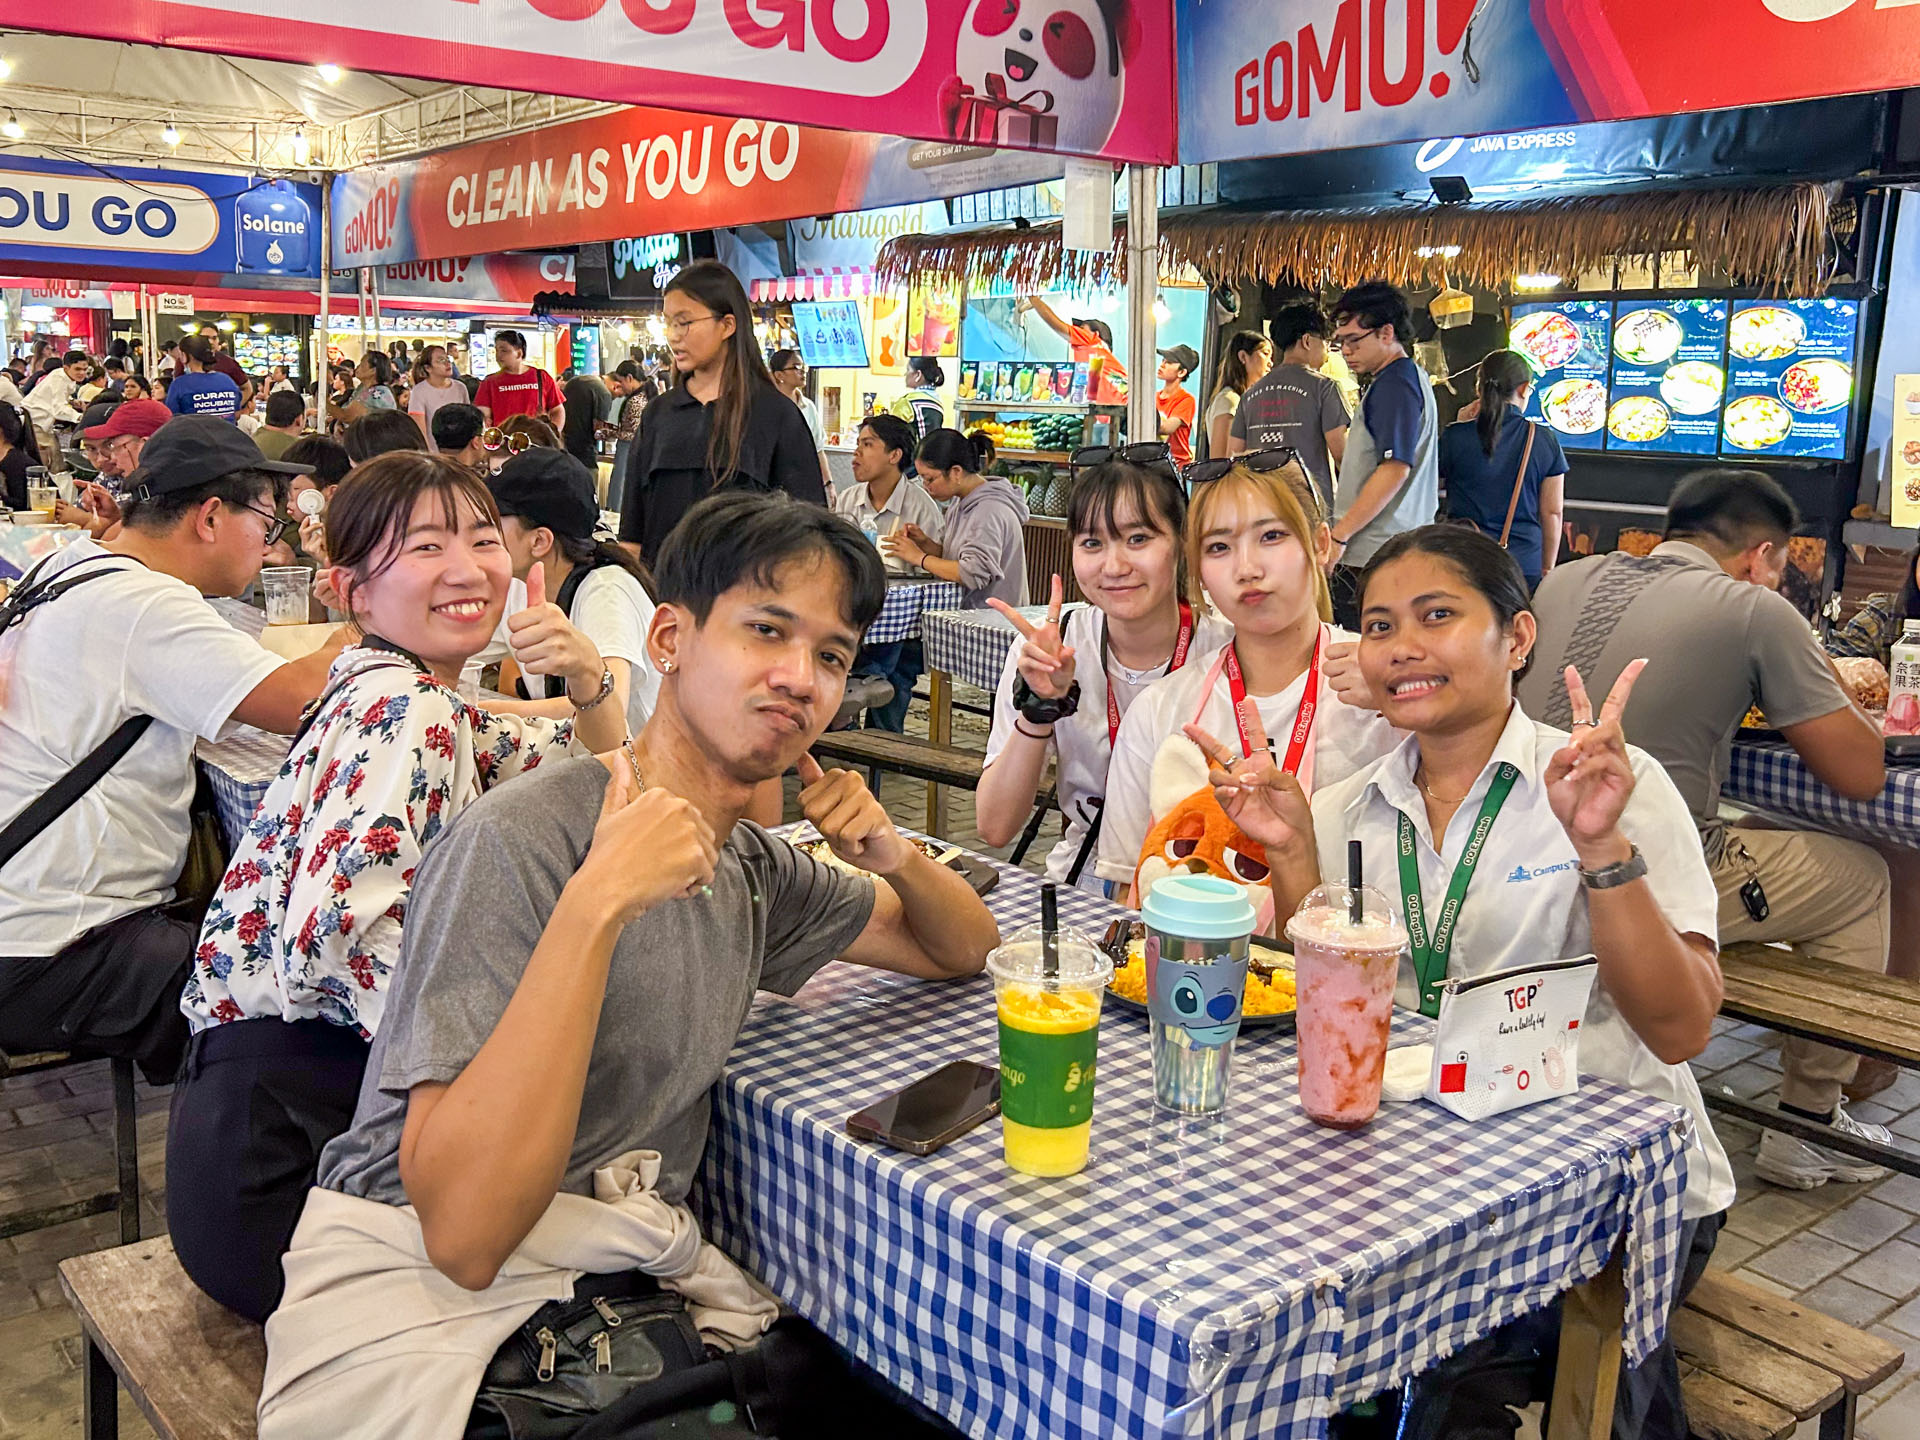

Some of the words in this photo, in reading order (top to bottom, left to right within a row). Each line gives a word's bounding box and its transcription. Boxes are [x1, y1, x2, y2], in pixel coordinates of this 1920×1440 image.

[724, 0, 890, 62] GO
[1234, 0, 1480, 126] GOMO!
[1470, 137, 1505, 153] JAVA
[1507, 131, 1576, 150] EXPRESS
[911, 152, 924, 162] GET
[925, 148, 941, 159] YOUR
[447, 158, 552, 229] CLEAN
[557, 148, 611, 213] AS
[621, 125, 714, 204] YOU
[724, 118, 800, 188] GO
[0, 186, 70, 231] OU
[92, 195, 177, 239] GO
[345, 176, 399, 254] GOMO!
[242, 213, 306, 235] Solane
[801, 205, 925, 252] Marigold
[192, 391, 236, 401] CURATE
[498, 383, 540, 392] SHIMANO
[1276, 384, 1308, 398] MACHINA
[193, 399, 235, 409] INCUBATE
[1469, 816, 1492, 851] English
[1463, 850, 1476, 866] QQ
[1533, 862, 1570, 876] Campus
[1407, 894, 1418, 910] QQ
[1410, 910, 1425, 948] English
[1439, 899, 1458, 937] English
[1435, 936, 1446, 953] QQ
[1504, 985, 1538, 1012] TGP
